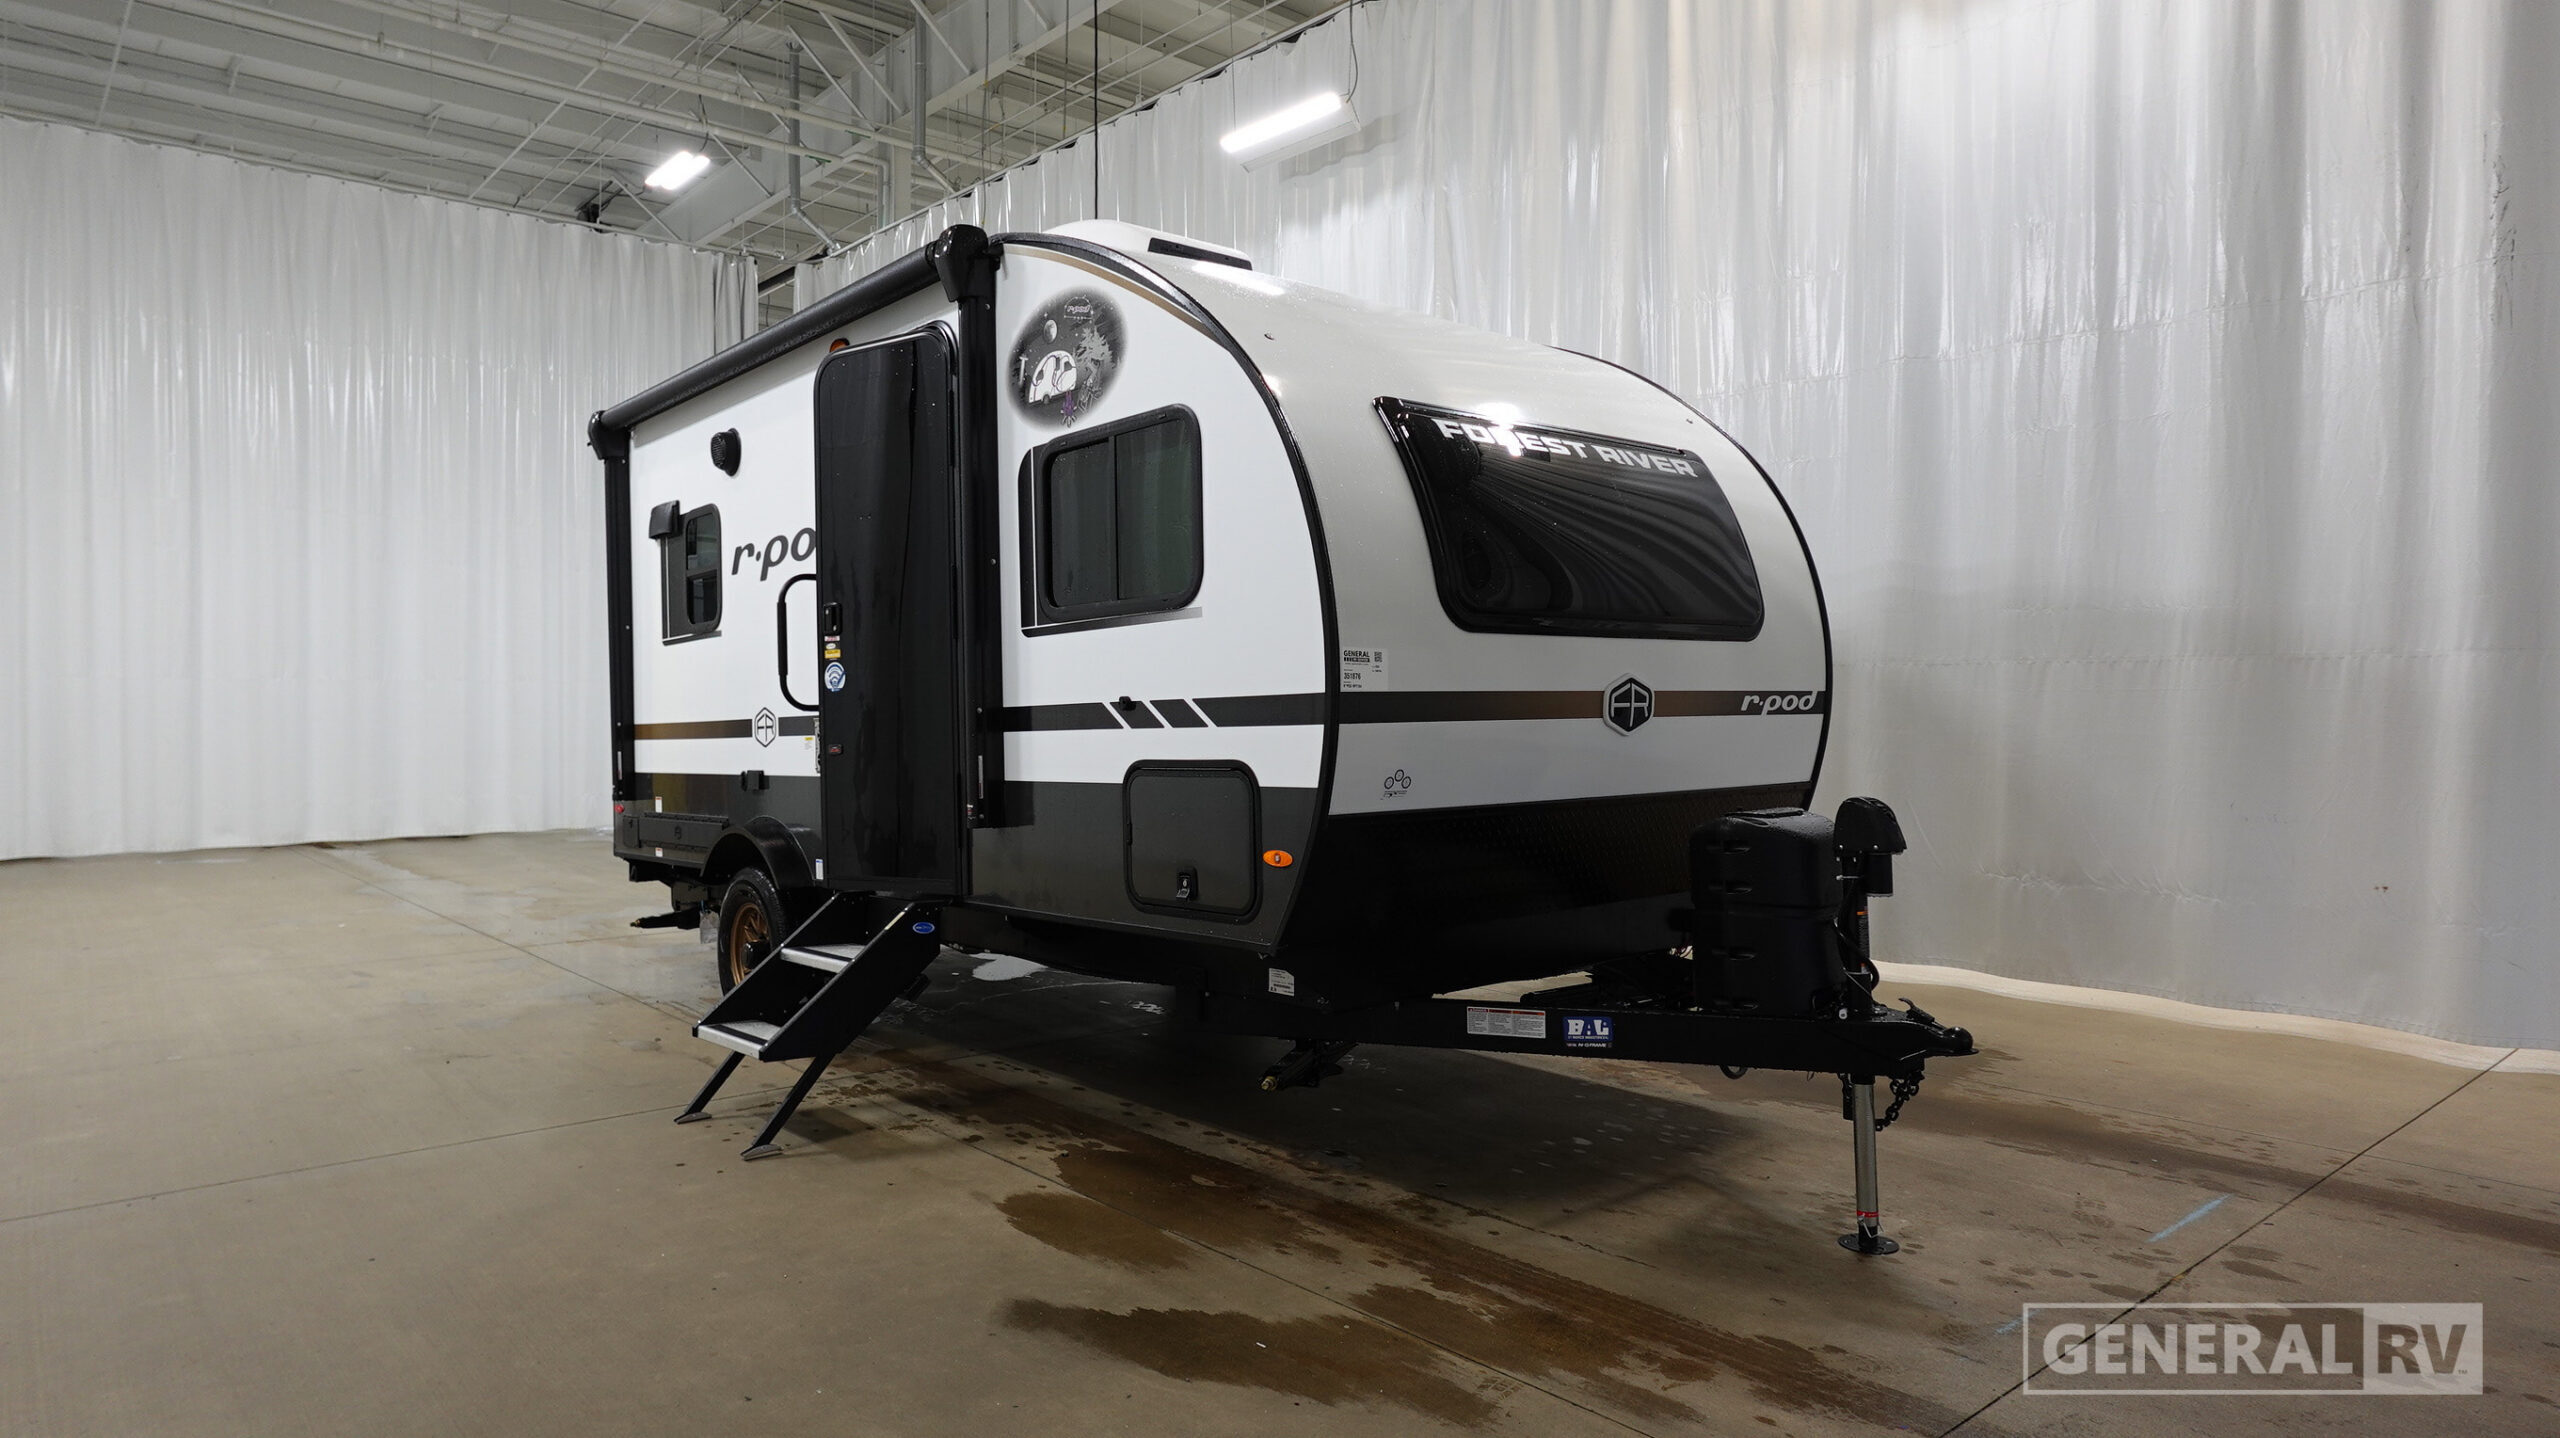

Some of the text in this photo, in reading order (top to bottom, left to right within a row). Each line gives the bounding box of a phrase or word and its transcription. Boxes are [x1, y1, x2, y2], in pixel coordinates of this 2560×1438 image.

[1592, 445, 1698, 477] RIVER
[1343, 650, 1370, 658] GENERAL
[1567, 1019, 1610, 1036] BAL
